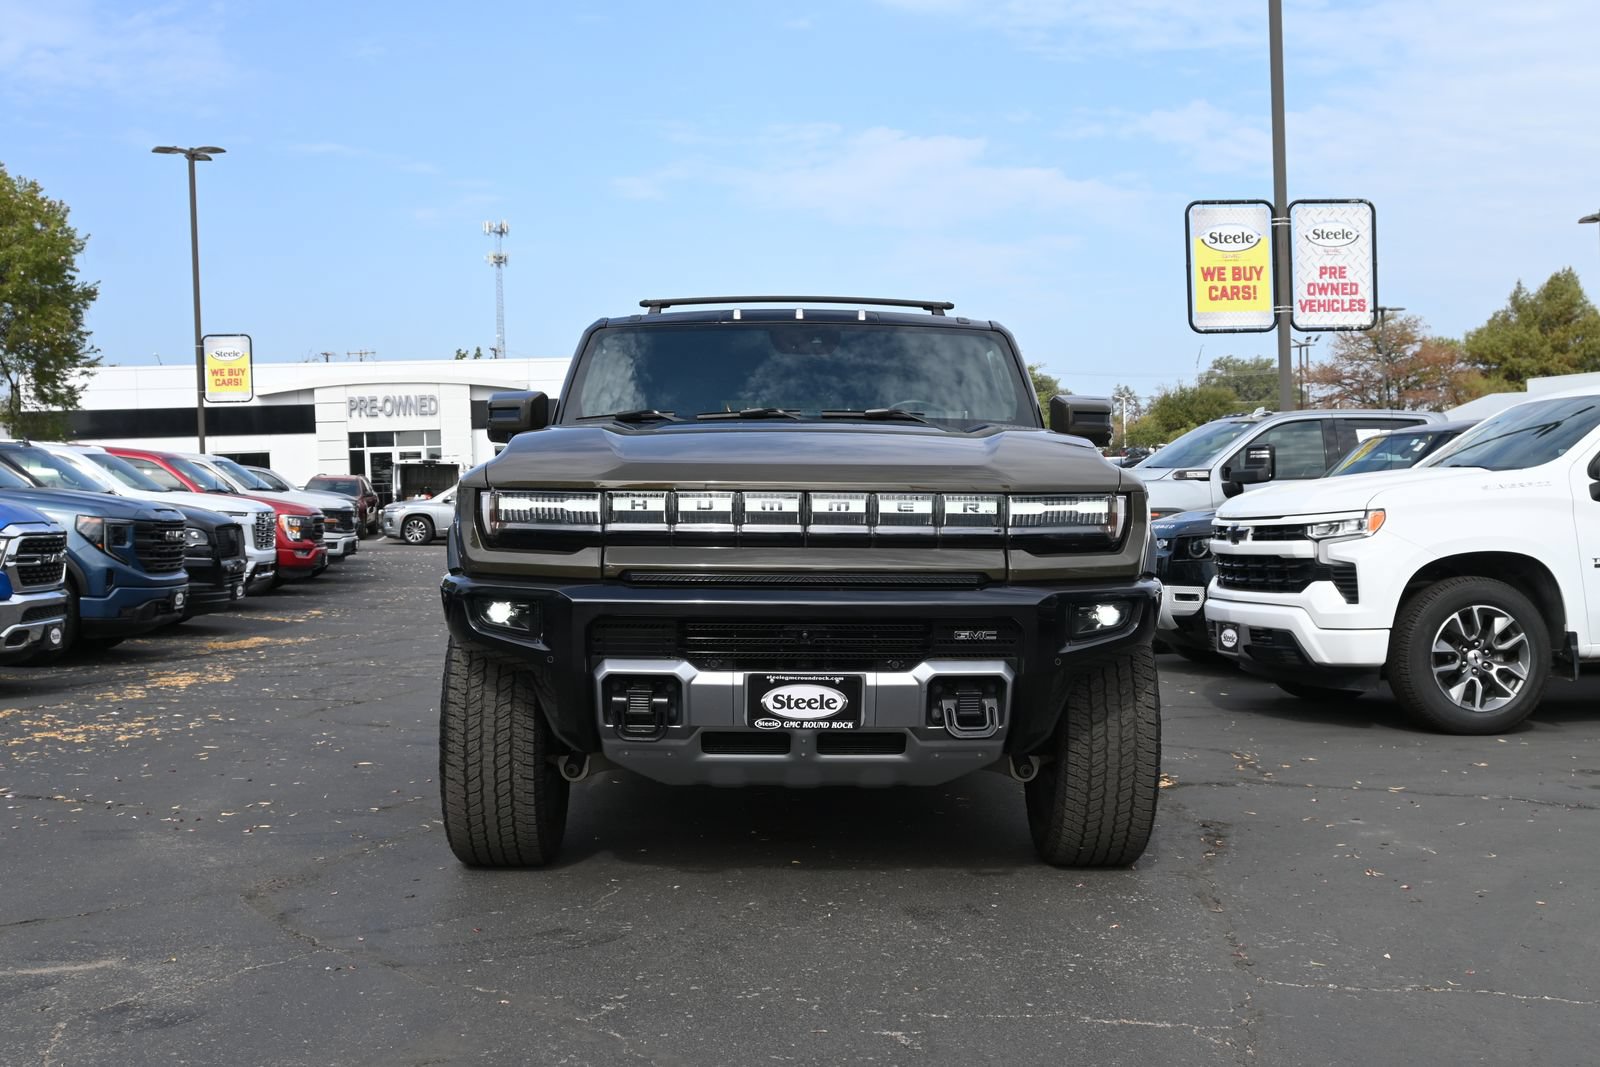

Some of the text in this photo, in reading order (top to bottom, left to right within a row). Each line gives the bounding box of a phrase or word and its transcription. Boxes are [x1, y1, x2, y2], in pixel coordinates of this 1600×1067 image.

[1208, 231, 1254, 244] Steele
[1312, 228, 1353, 240] Steele
[1200, 265, 1264, 282] WE BUY
[1319, 266, 1347, 279] PRE
[1208, 285, 1258, 301] CARS!
[1307, 282, 1359, 296] OWNED
[1299, 299, 1366, 312] VEHICLES
[210, 368, 246, 377] WE BUY
[214, 378, 242, 387] CARS!
[347, 394, 439, 418] PRE-OWNED
[953, 630, 998, 640] GMC
[772, 694, 838, 710] Steele
[831, 721, 854, 729] ROCK
